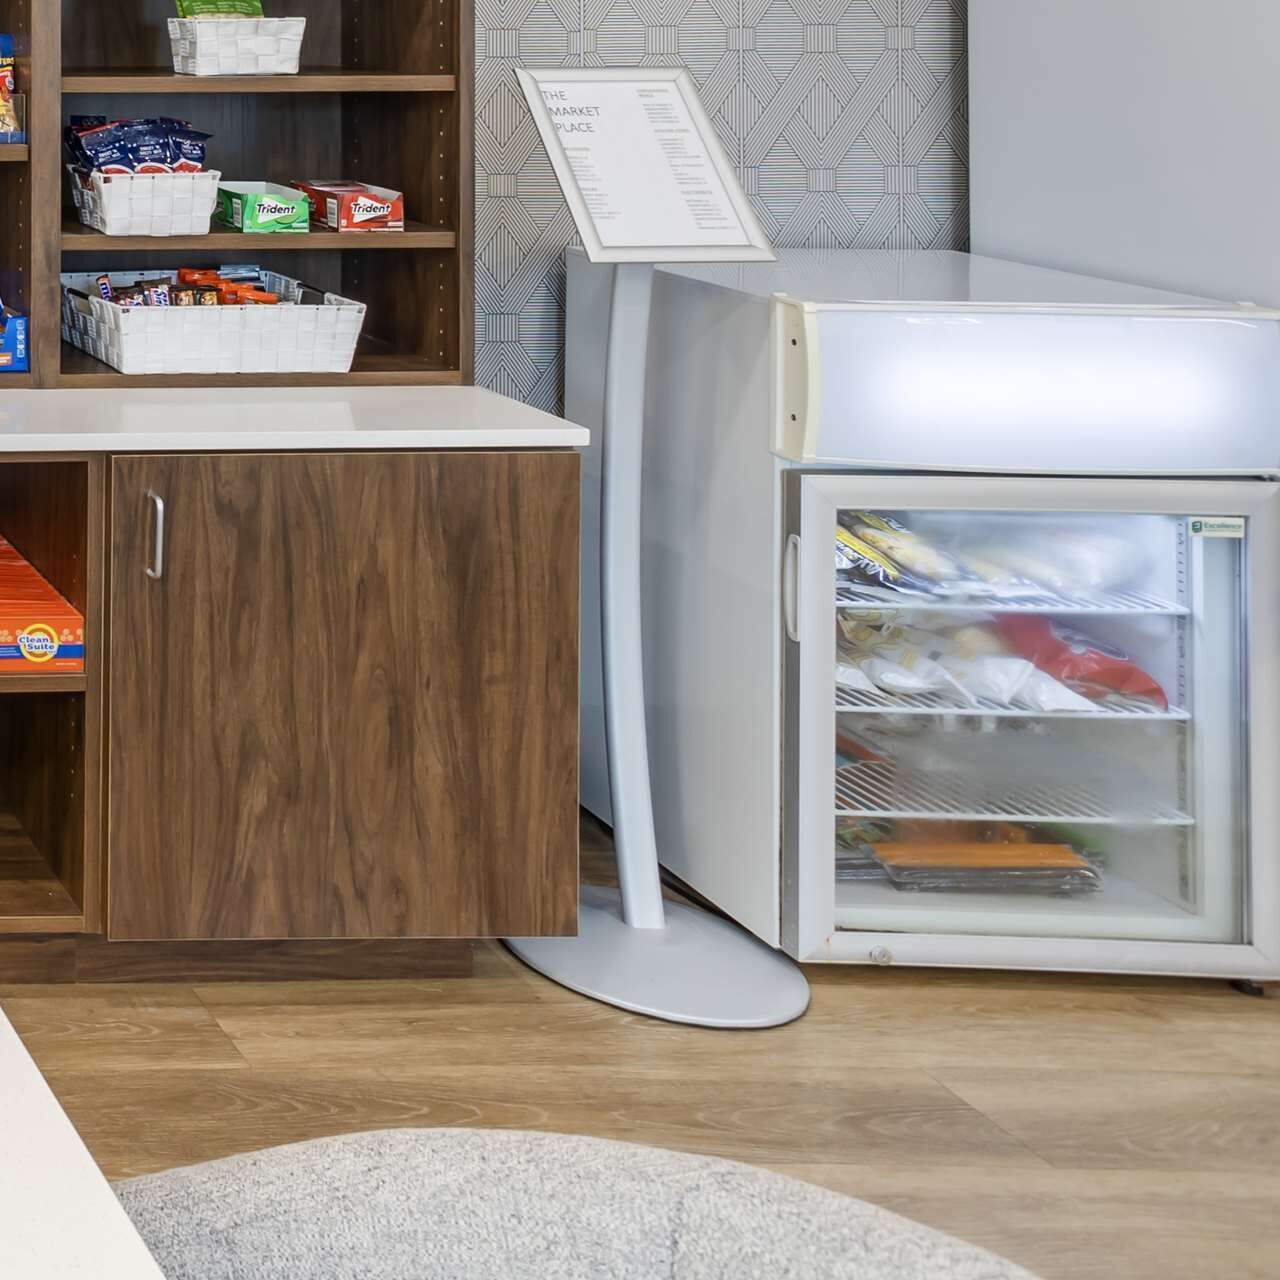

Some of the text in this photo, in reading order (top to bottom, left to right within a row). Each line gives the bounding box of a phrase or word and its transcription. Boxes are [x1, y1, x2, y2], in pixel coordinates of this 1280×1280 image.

[542, 91, 568, 101] THE
[548, 107, 600, 117] MARKET
[553, 122, 595, 133] PLACE
[256, 203, 297, 214] Trident
[351, 202, 391, 214] Trident
[19, 637, 49, 645] Clean
[27, 644, 55, 652] Suite
